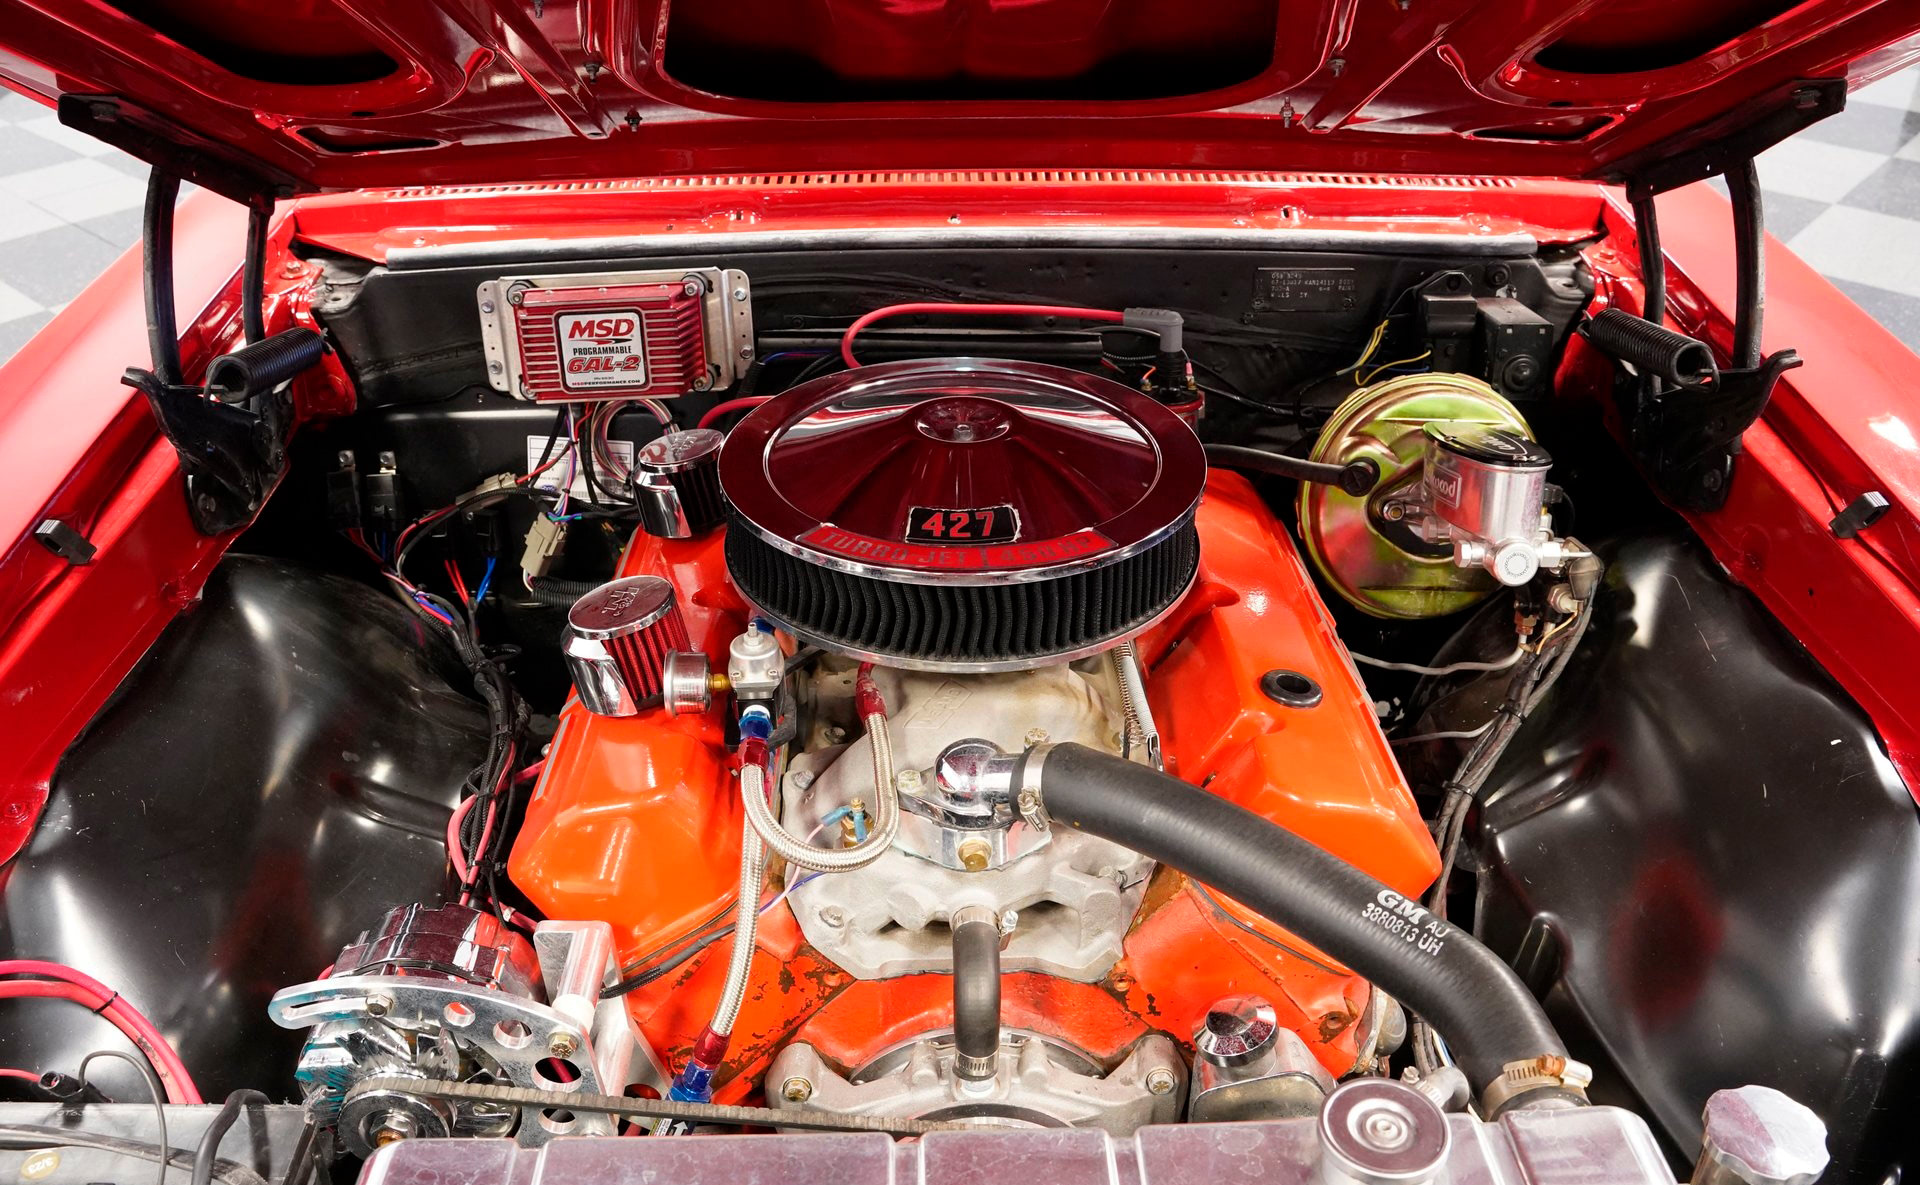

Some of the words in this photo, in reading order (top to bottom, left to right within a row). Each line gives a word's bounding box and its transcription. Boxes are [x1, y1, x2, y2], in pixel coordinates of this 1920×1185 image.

[568, 318, 634, 338] MSD
[573, 345, 632, 356] PROGRAMMABLE
[567, 355, 641, 375] 6AL-2
[921, 511, 995, 538] 427
[1377, 889, 1429, 925] GM
[1425, 920, 1451, 938] AU
[1361, 902, 1420, 942] 3880813
[1418, 933, 1444, 956] UH
